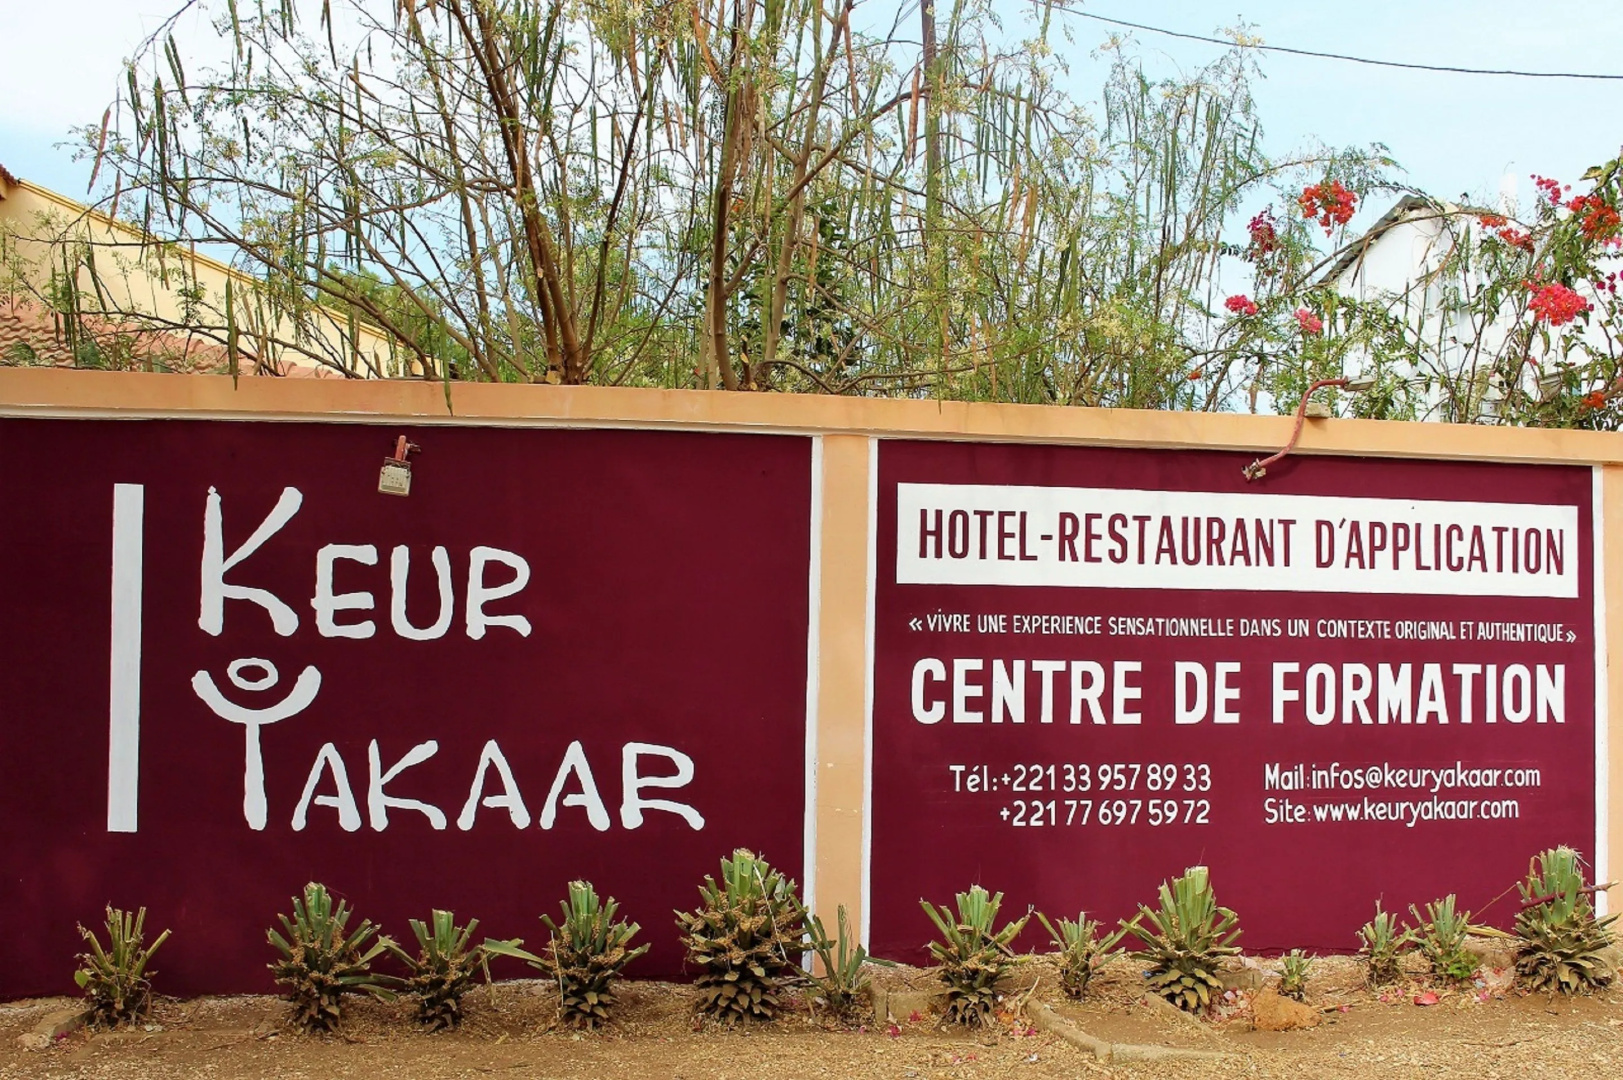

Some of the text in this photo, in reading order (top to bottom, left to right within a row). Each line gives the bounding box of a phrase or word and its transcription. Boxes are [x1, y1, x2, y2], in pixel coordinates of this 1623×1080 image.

[198, 486, 532, 641] KEUR
[919, 508, 1564, 576] HOTEL-RESTAURANT D'APPLICATION
[977, 614, 1008, 634] UNE
[1013, 615, 1102, 635] EXPERIENCE
[1108, 616, 1234, 637] SENSATIONNELLE
[1239, 618, 1282, 637] DANS
[1287, 618, 1310, 638] UN
[1316, 618, 1392, 639] CONTEXTE
[1394, 620, 1457, 641] ORIGINAL
[1460, 621, 1475, 641] ET
[911, 657, 1566, 726] CENTRE DE FORMATION
[191, 657, 706, 832] YAKAAR
[1063, 763, 1093, 792] 33
[1097, 763, 1141, 791] 957
[1146, 763, 1178, 791] 89
[1182, 763, 1212, 792] 33
[999, 799, 1211, 827] +221 77 697 59 72
